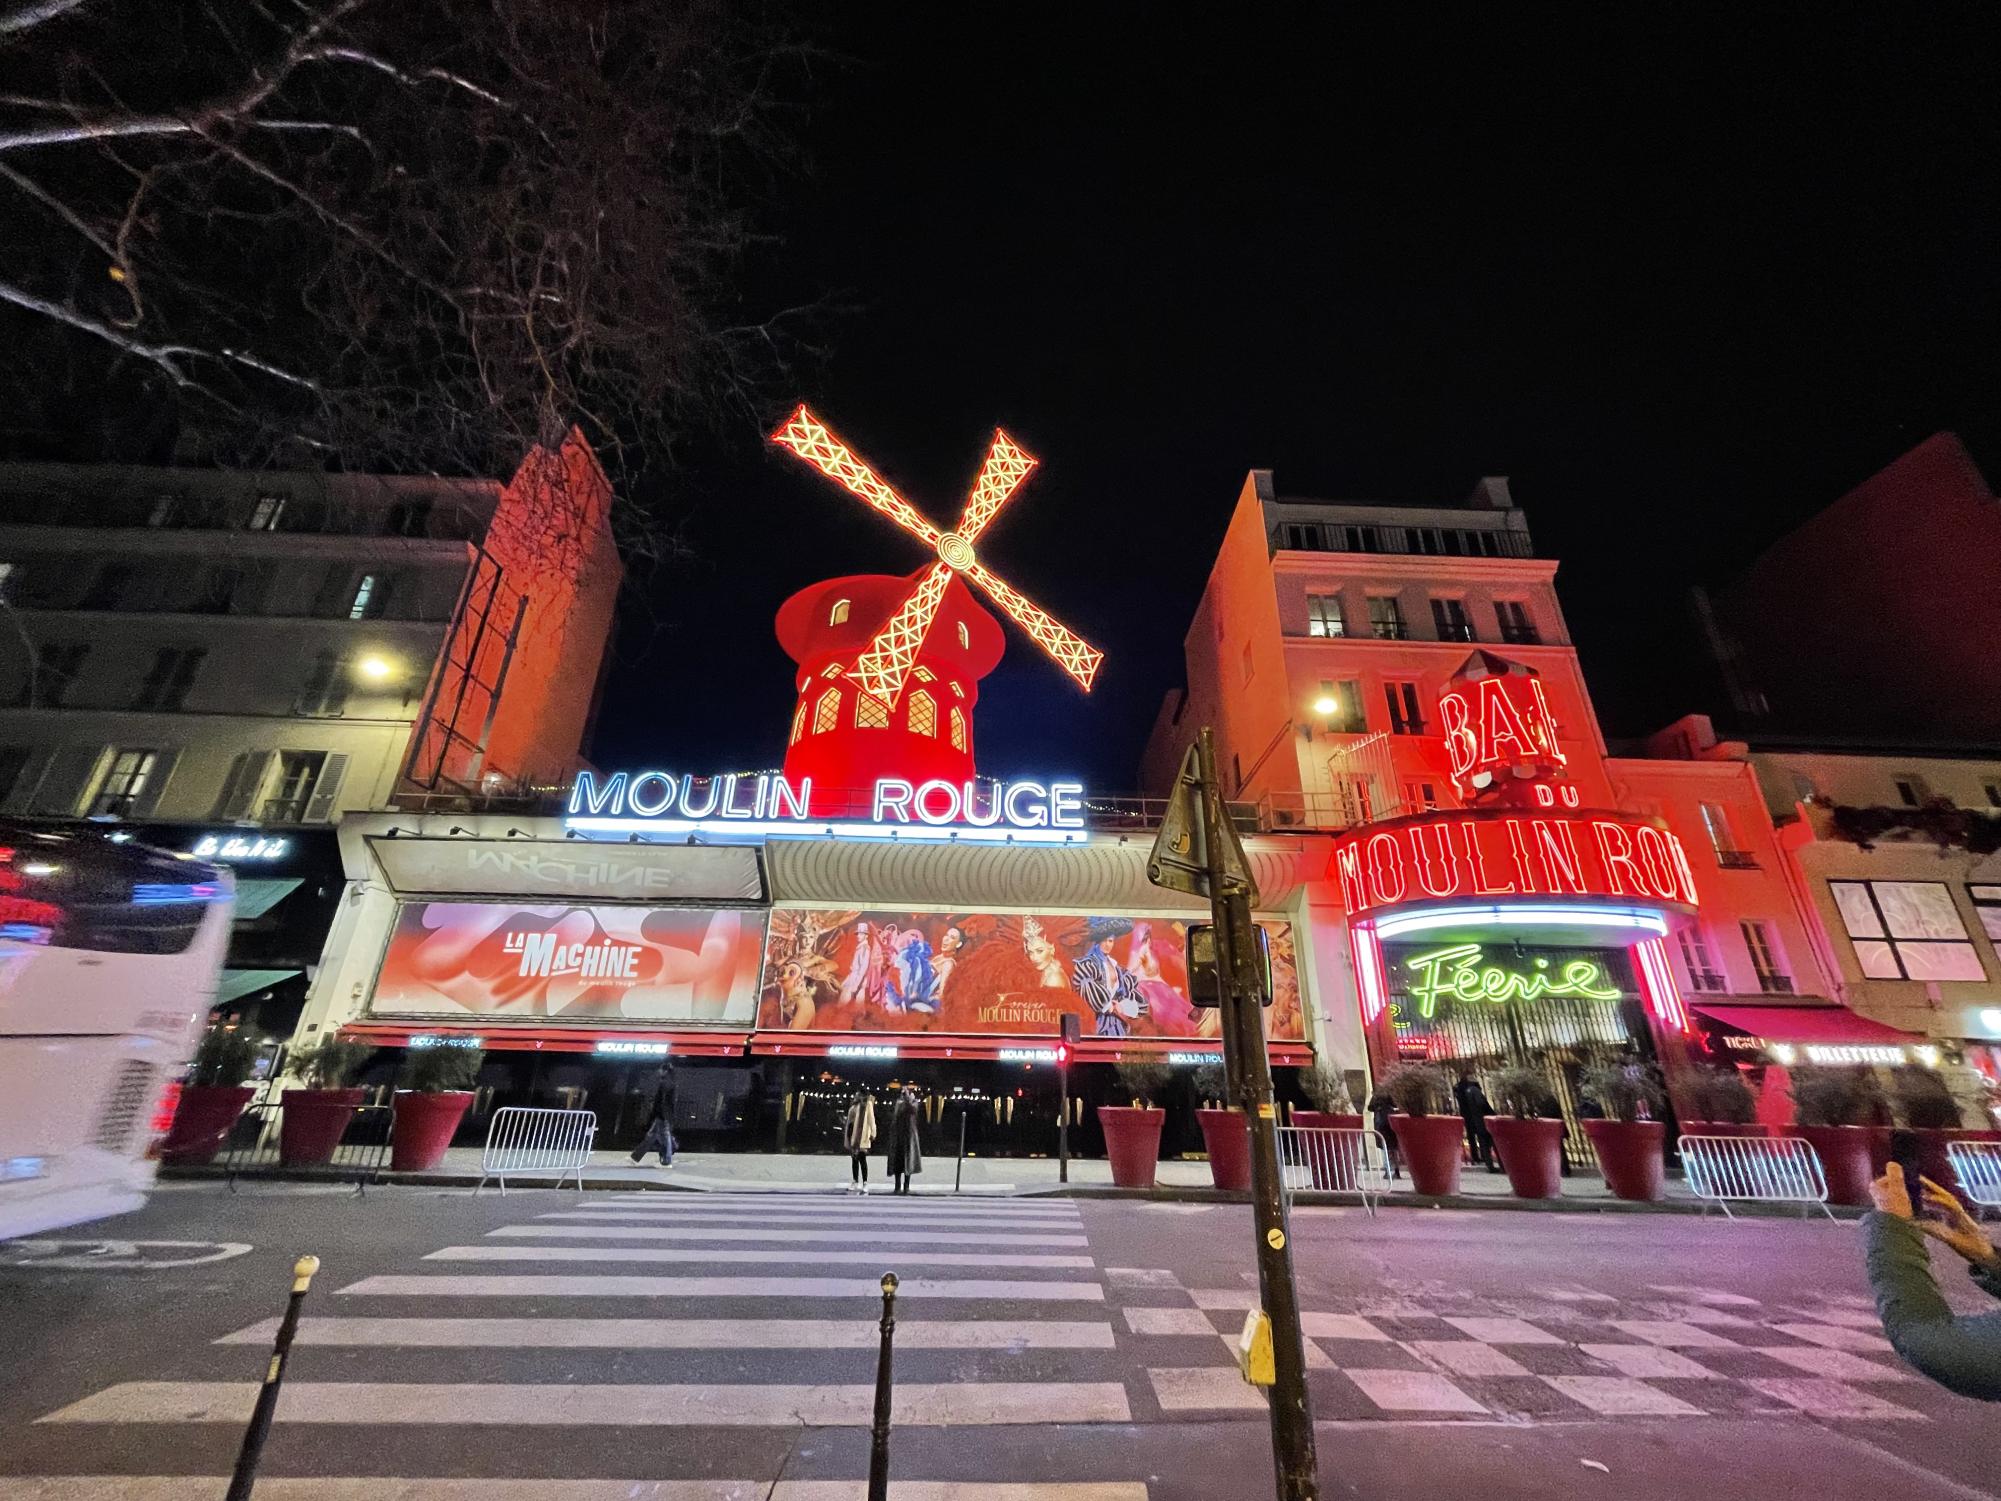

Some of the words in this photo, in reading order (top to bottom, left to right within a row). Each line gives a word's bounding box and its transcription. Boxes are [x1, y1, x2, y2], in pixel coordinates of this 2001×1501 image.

[567, 771, 812, 820] MOULIN
[873, 778, 1084, 827] ROUGE
[1535, 784, 1579, 807] DU
[1336, 819, 1588, 916] MOULIN
[505, 932, 526, 948] LA
[1405, 944, 1622, 1018] Féerie
[988, 991, 1047, 1009] Forever
[978, 1007, 1020, 1023] MOULIN
[829, 1046, 865, 1056] MOULIN
[866, 1046, 898, 1057] ROUGE
[1000, 1049, 1034, 1059] MOULIN
[1036, 1050, 1058, 1060] ROU
[1169, 1053, 1203, 1063] MOULIN
